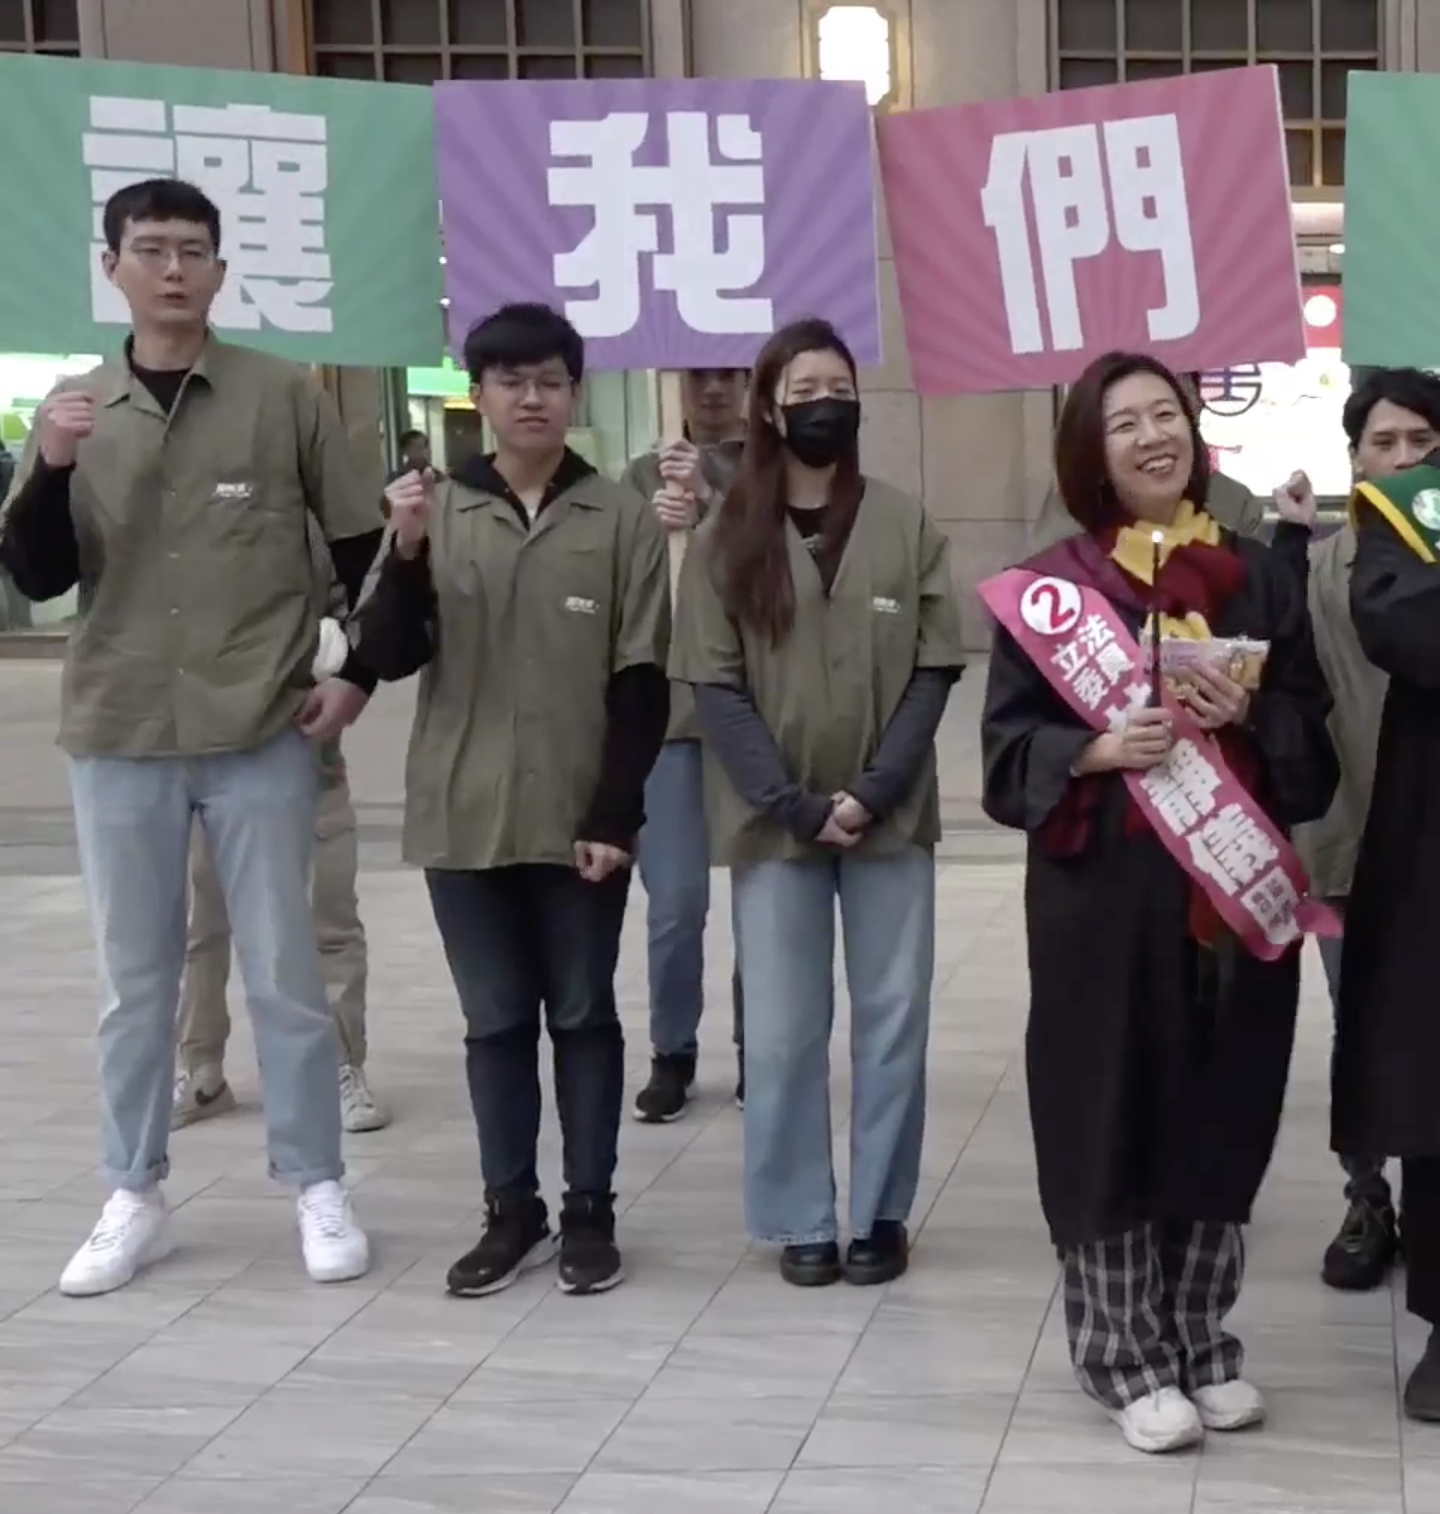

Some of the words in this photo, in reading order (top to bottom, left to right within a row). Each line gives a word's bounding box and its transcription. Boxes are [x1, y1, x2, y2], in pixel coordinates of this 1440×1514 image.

[82, 95, 334, 333] 讓
[546, 110, 775, 337] 我
[980, 113, 1200, 355] 們
[1030, 583, 1075, 631] 2
